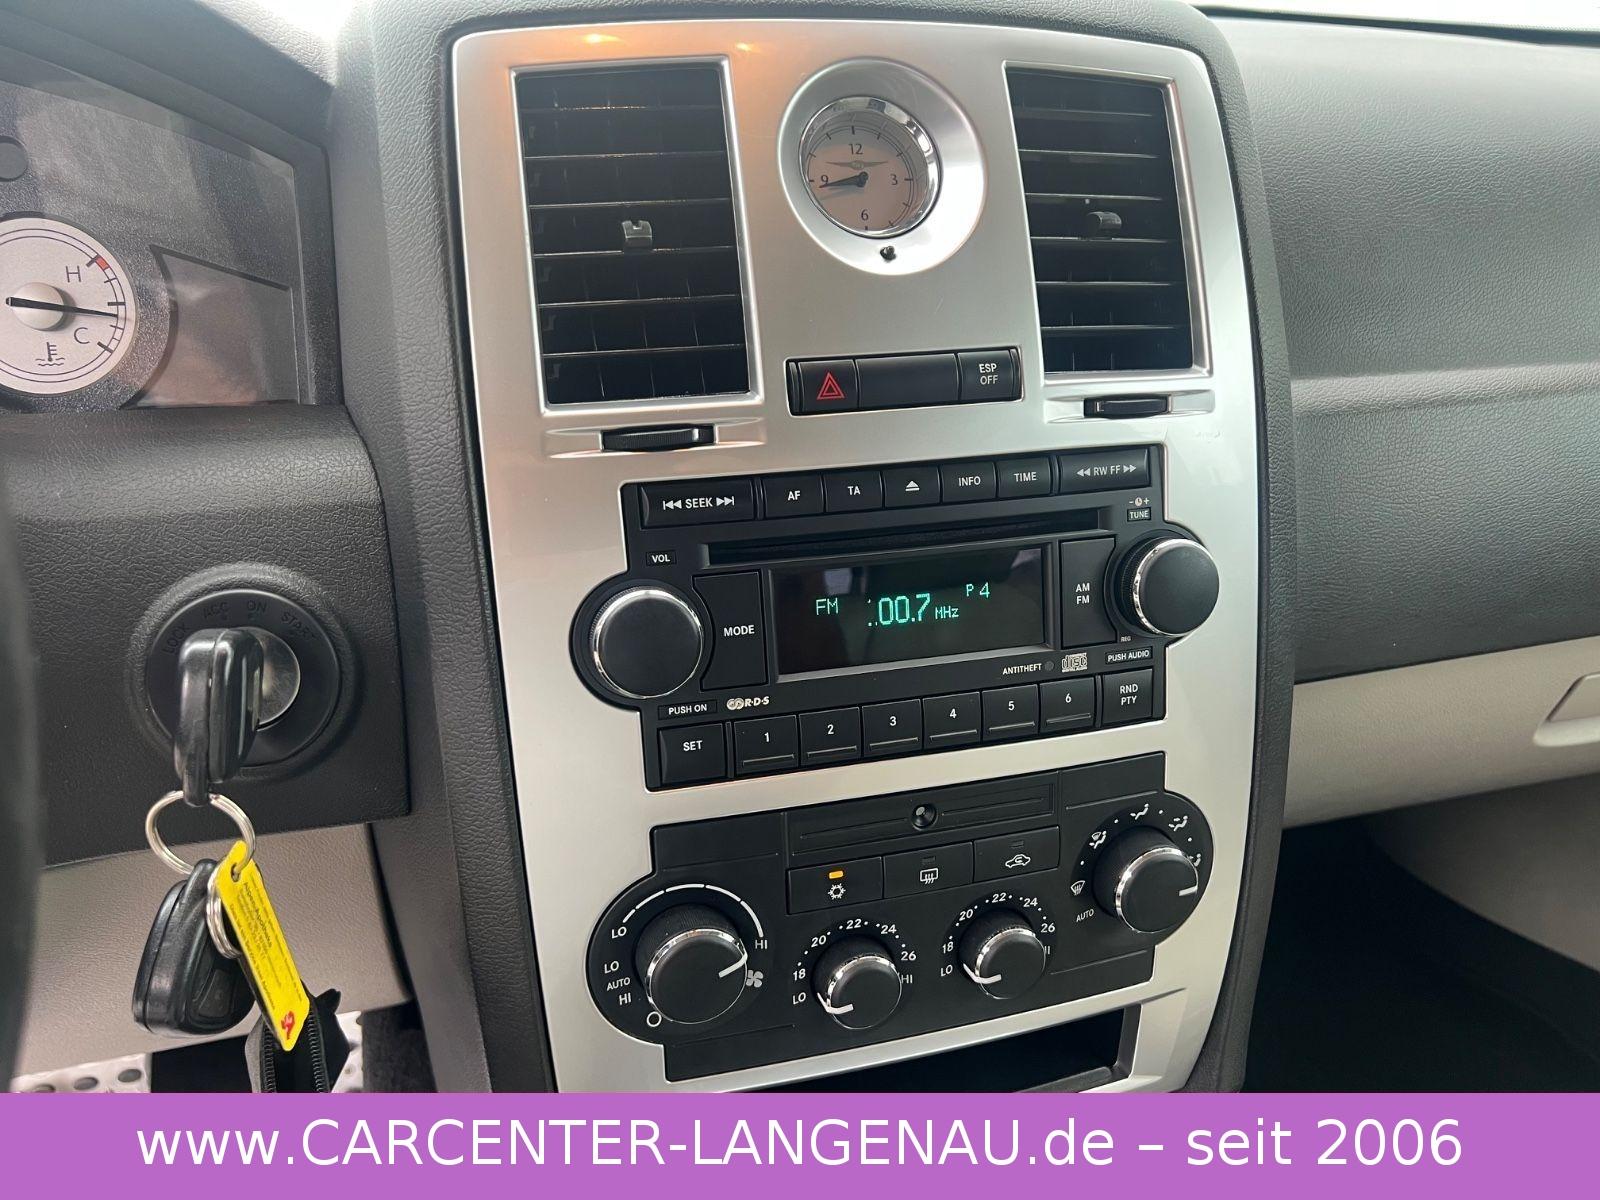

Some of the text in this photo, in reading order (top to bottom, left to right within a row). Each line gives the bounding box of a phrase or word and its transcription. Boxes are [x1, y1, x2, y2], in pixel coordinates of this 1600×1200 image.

[849, 143, 863, 155] 12
[820, 174, 829, 185] 9
[891, 173, 898, 185] 3
[861, 209, 869, 221] 6
[65, 265, 81, 283] H
[73, 327, 90, 344] C
[979, 363, 997, 373] ESP
[980, 375, 998, 385] OFF
[1093, 465, 1121, 476] RW FF
[958, 476, 981, 487] INFO
[1013, 472, 1037, 482] TIME
[787, 490, 801, 501] AF
[847, 486, 861, 496] TA
[685, 497, 713, 509] SEEK
[1129, 509, 1149, 520] TUNE
[651, 554, 671, 563] VOL
[966, 581, 991, 599] P 4
[1075, 583, 1090, 593] AM
[1076, 595, 1090, 605] FM
[246, 600, 267, 613] ON
[815, 597, 839, 616] FM
[935, 605, 960, 619] MHz
[723, 625, 755, 637] MODE
[1107, 650, 1150, 662] PUSH AUDIO
[1002, 662, 1043, 675] ANTITHEFT
[1119, 683, 1139, 694] RND
[1065, 693, 1072, 703] 6
[1120, 695, 1137, 706] PTY
[668, 704, 708, 715] PUSH ON
[1008, 701, 1015, 711] 5
[949, 708, 957, 719] 4
[889, 716, 897, 726] 3
[827, 725, 834, 735] 2
[764, 732, 770, 743] 1
[683, 740, 703, 752] SET
[991, 892, 1007, 903] 22
[1023, 898, 1038, 908] 24
[959, 909, 974, 922] 20
[1076, 908, 1095, 922] AUTO
[845, 918, 862, 930] 22
[880, 924, 897, 935] 24
[1040, 923, 1056, 933] 26
[611, 926, 627, 939] LO
[754, 939, 768, 949] HI
[811, 935, 827, 948] 20
[942, 941, 954, 954] 18
[900, 951, 917, 961] 26
[604, 960, 620, 974] LO
[940, 965, 953, 977] LO
[792, 968, 806, 981] 18
[901, 974, 913, 984] HI
[606, 977, 631, 991] AUTO
[618, 992, 632, 1006] HI
[792, 992, 807, 1005] LO
